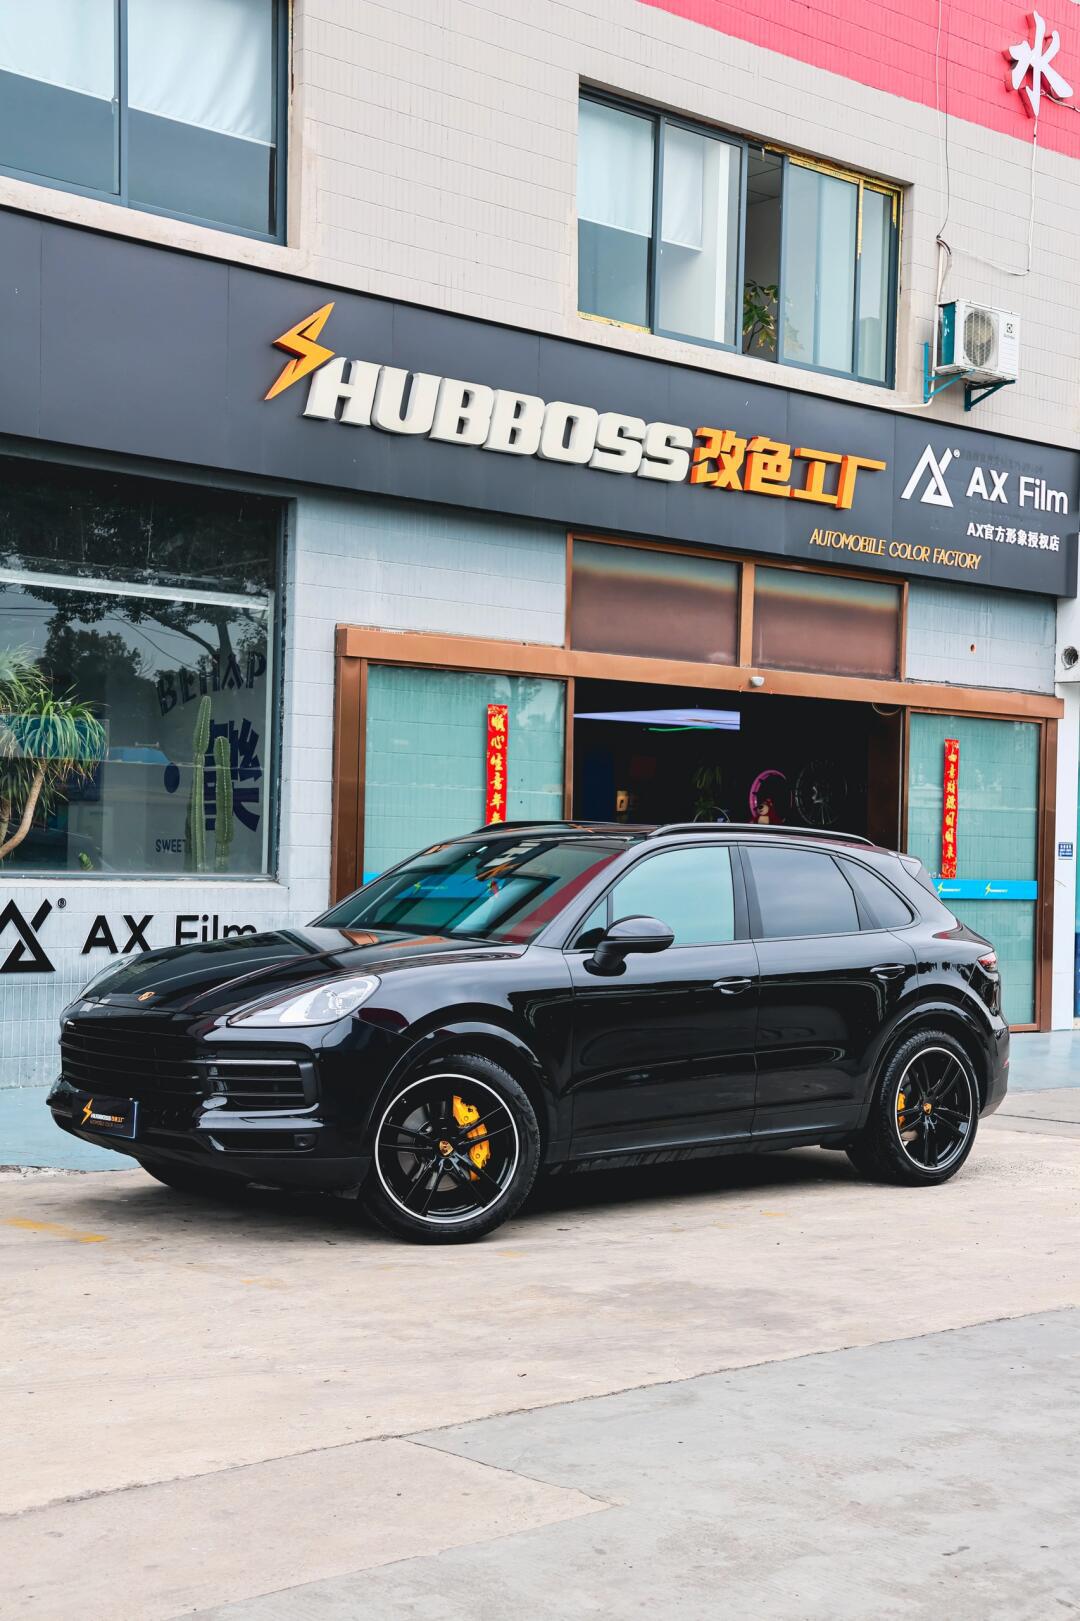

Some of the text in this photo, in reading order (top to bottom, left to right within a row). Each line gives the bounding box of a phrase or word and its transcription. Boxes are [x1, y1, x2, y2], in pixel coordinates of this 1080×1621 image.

[1003, 10, 1073, 117] 水
[690, 426, 887, 510] 改色工厂
[965, 466, 1069, 515] AX Film
[809, 528, 982, 570] AUTOMOBILE COLOR FACTORY
[155, 838, 187, 853] SWEE
[81, 914, 155, 954] AX
